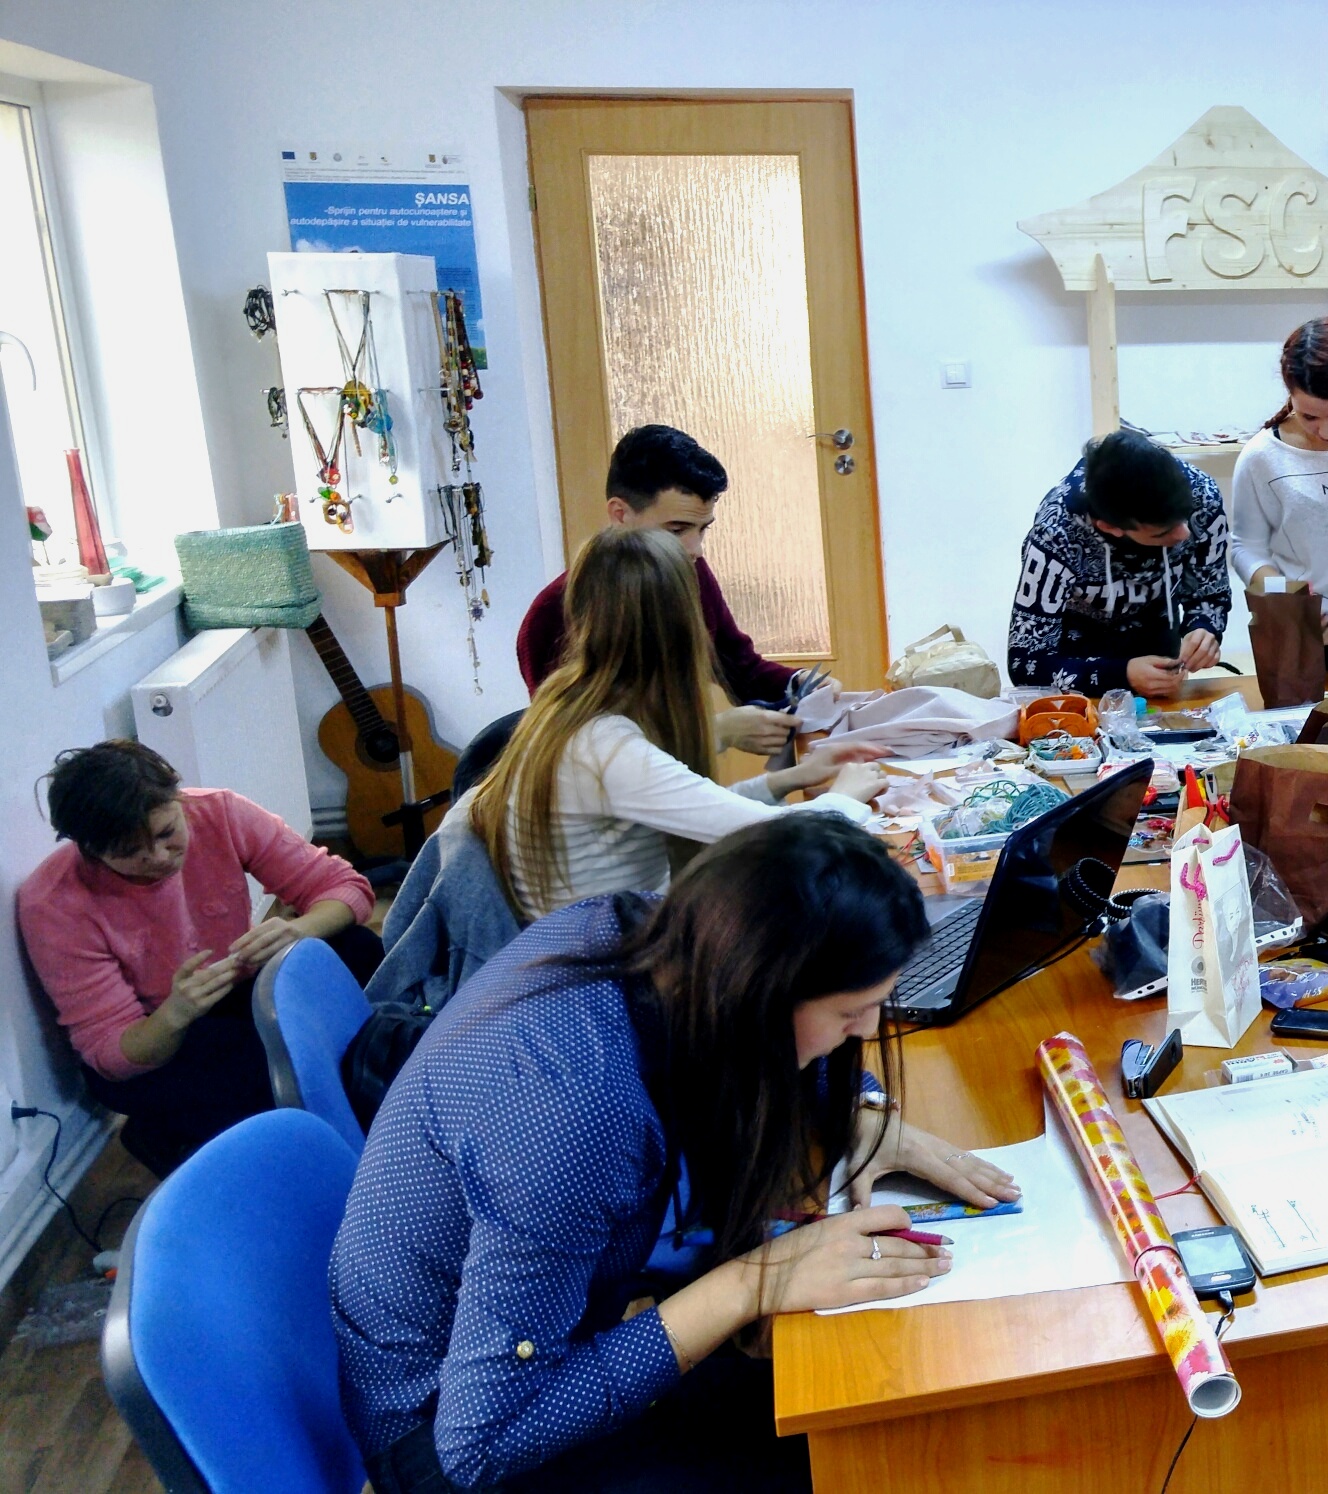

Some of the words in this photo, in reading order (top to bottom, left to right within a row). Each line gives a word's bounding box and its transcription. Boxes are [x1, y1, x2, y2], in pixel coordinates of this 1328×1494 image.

[358, 208, 387, 217] pentru
[410, 218, 472, 227] vulnerabilitate
[1143, 176, 1323, 284] FSC
